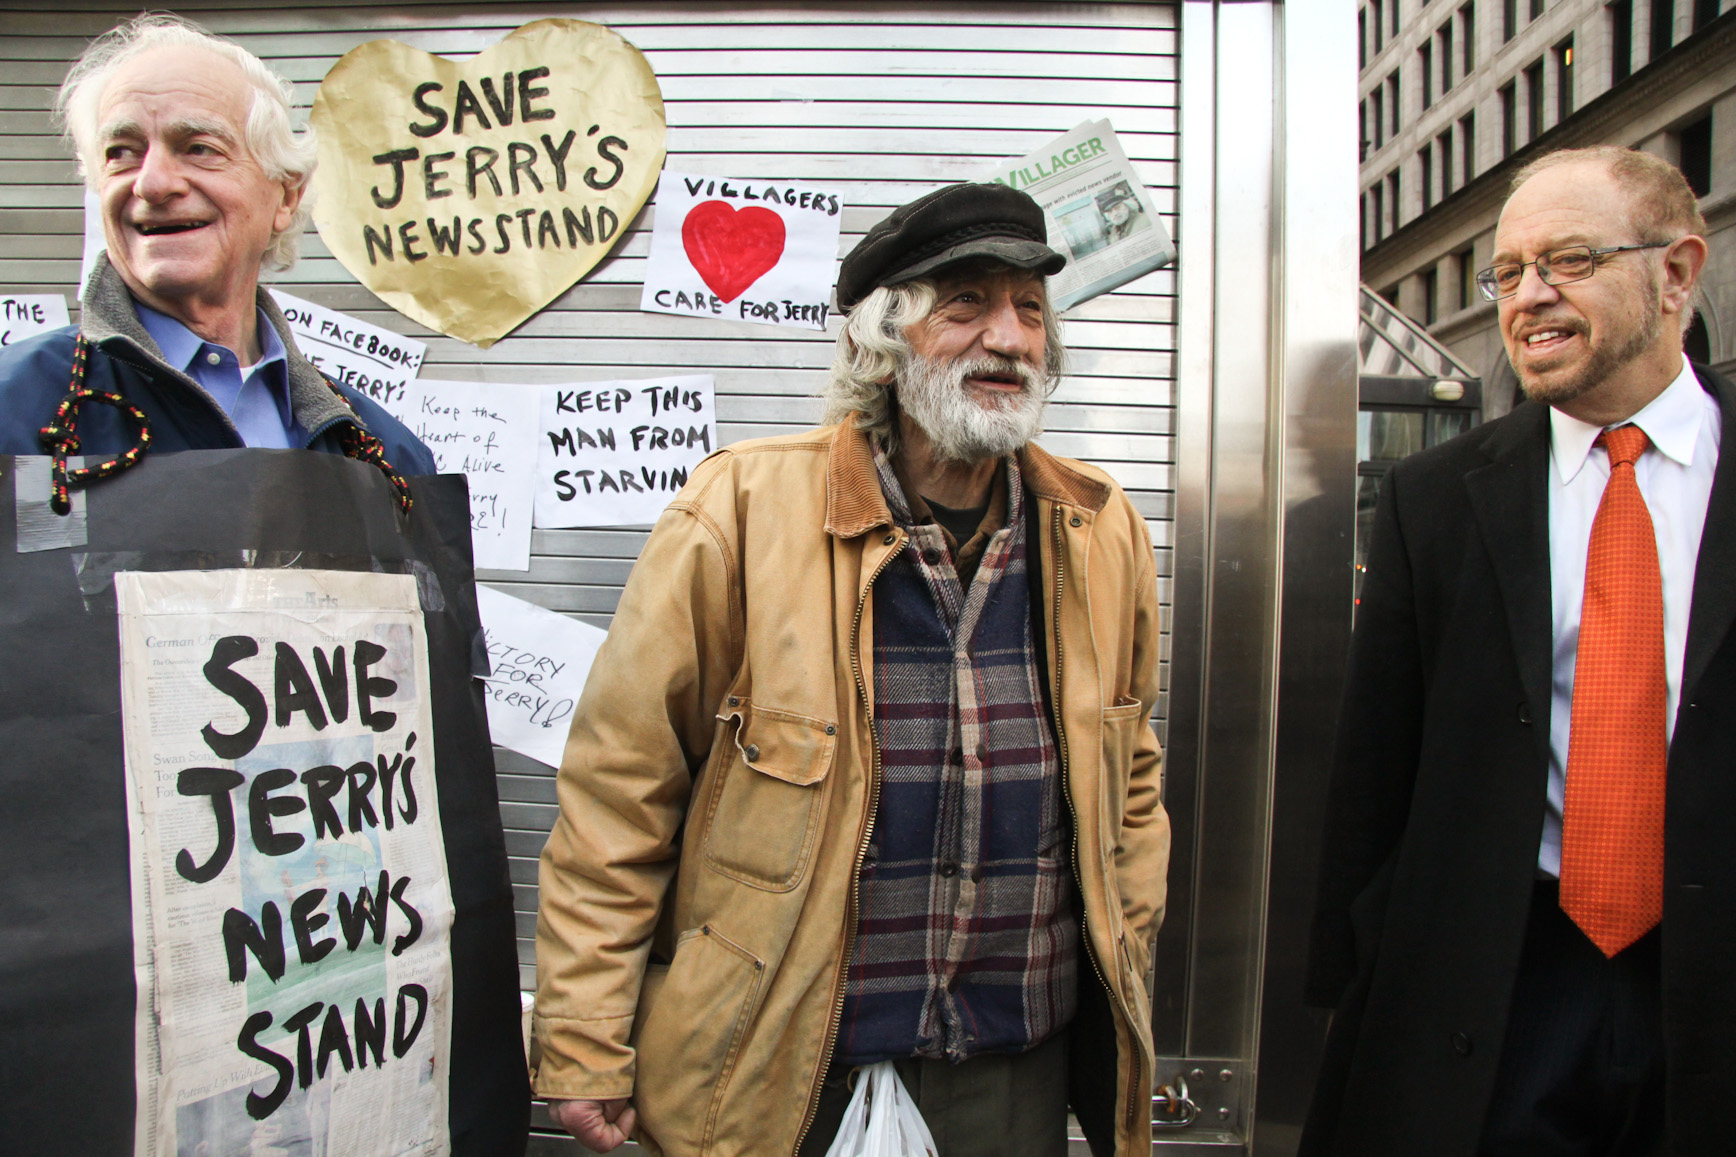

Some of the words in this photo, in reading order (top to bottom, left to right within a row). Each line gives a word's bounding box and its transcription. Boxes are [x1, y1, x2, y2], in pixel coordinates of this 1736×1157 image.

[409, 66, 556, 137] SAVE
[371, 124, 629, 209] JERRY'S
[994, 137, 1107, 190] VILLAGER
[684, 177, 839, 216] VILLAGERS
[1067, 186, 1087, 199] evicted
[1087, 180, 1103, 190] news
[1103, 171, 1123, 183] vendor
[363, 205, 619, 265] NEWSSTAND
[2, 299, 46, 325] THE
[283, 309, 312, 328] ON
[655, 290, 722, 314] CARE
[740, 300, 779, 323] FOR
[780, 300, 830, 331] JERRY
[421, 395, 460, 421] Keep
[472, 407, 507, 424] the
[556, 388, 632, 415] KEEP
[641, 385, 703, 417] THIS
[473, 431, 499, 455] of
[547, 427, 616, 457] MAN
[630, 423, 710, 454] FROM
[146, 635, 194, 648] German
[493, 663, 547, 695] FOR
[201, 635, 398, 760] SAVE
[153, 753, 186, 766] Swan
[188, 750, 217, 765] Song
[175, 731, 418, 883] JERRY'S
[222, 870, 423, 983] NEWS
[237, 982, 428, 1119] STAND
